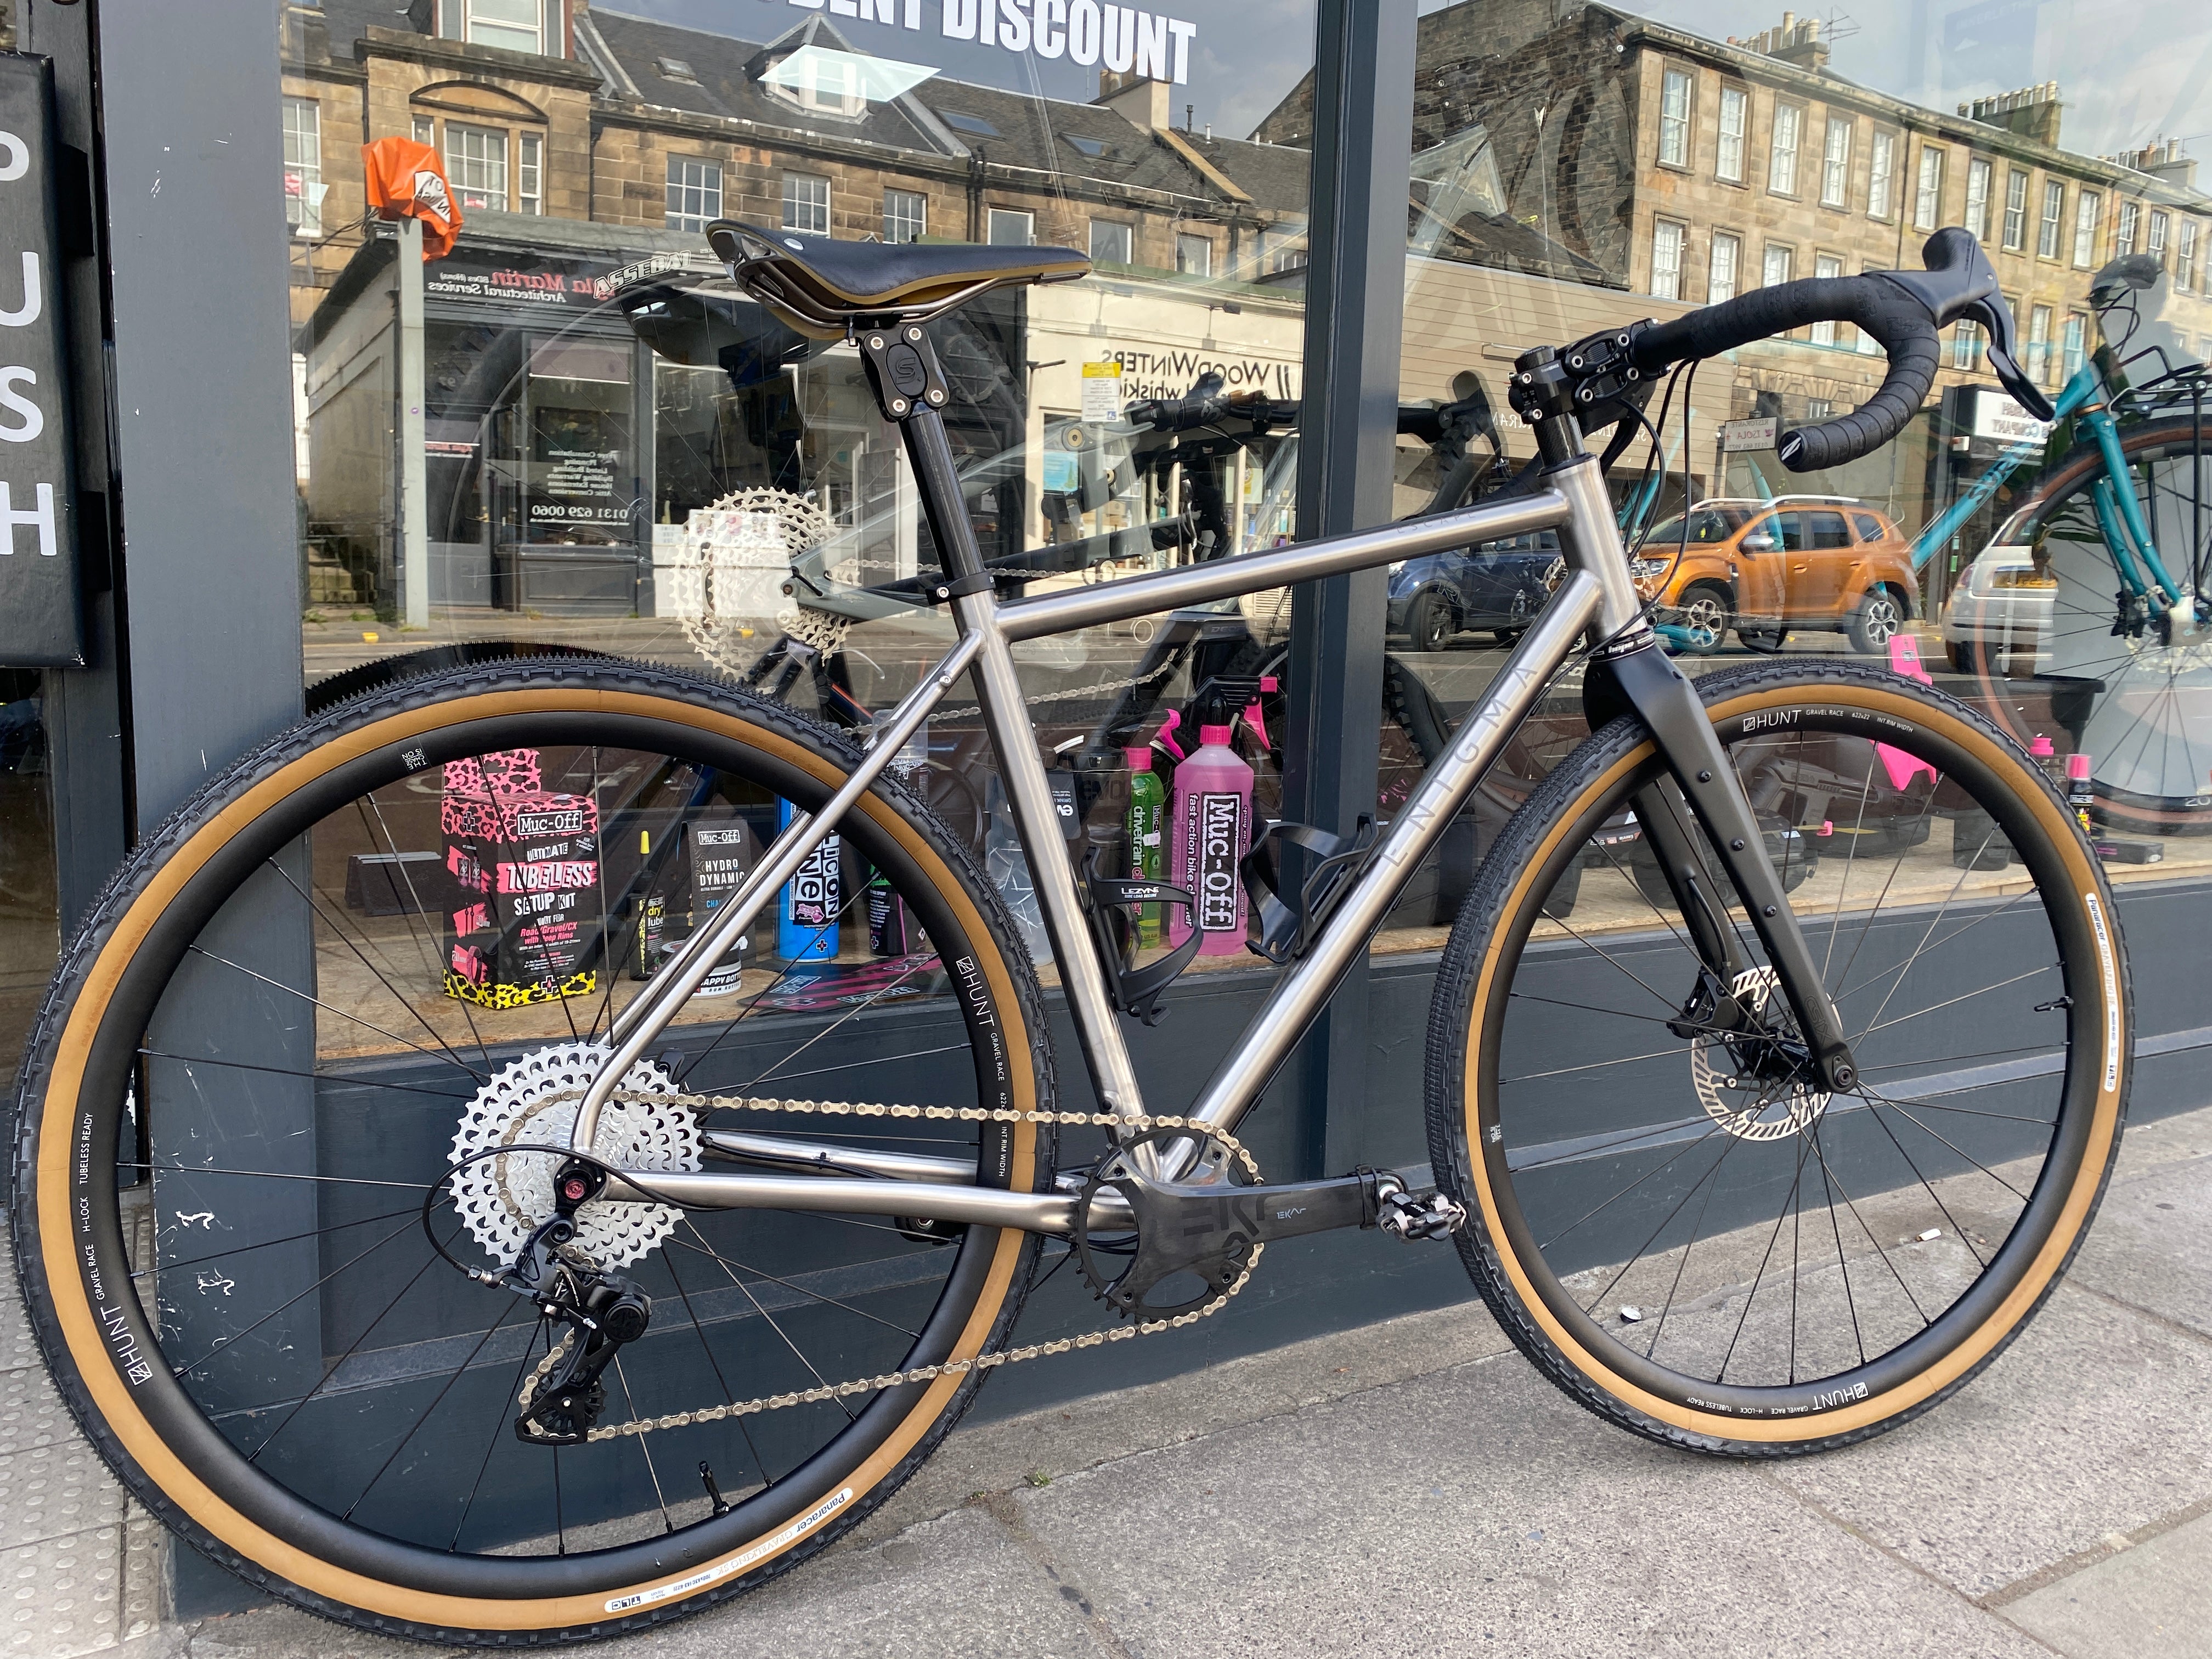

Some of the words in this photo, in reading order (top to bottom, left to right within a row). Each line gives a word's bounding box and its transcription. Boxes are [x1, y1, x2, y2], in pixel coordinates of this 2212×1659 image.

[943, 0, 1197, 85] DISCOUNT
[593, 250, 691, 300] ASSEGAI
[1609, 641, 1634, 653] hope
[1757, 709, 1802, 729] HUNT
[1380, 665, 1538, 867] ENIGMA
[1189, 793, 1198, 816] fast
[521, 813, 580, 832] Muc-Off
[700, 831, 738, 843] Muc-Off
[1132, 805, 1146, 866] drivetrain
[1188, 818, 1198, 856] action
[527, 842, 568, 862] ULTIMATE
[1205, 801, 1234, 924] Muc-Off
[506, 862, 592, 890] TUBELESS
[706, 859, 738, 872] HYDRO
[1187, 858, 1197, 882] bike
[699, 871, 745, 886] DYNAMIC
[514, 892, 555, 916] SETUP
[558, 893, 575, 910] KIT
[648, 906, 662, 916] dry
[534, 916, 551, 927] UILT
[553, 913, 565, 923] FOR
[648, 917, 664, 927] lube
[2089, 899, 2106, 941] Panaracer
[701, 977, 725, 986] APPY
[963, 972, 995, 1026] HUNT
[991, 1032, 1000, 1060] GRAVEL
[996, 1062, 1005, 1081] RACE
[82, 1113, 93, 1142] READY
[80, 1143, 90, 1185] TUBELESS
[998, 1154, 1007, 1177] WIDTH
[81, 1197, 91, 1232] H-LOCK
[85, 1243, 95, 1265] RACE
[91, 1265, 105, 1300] GRAVEL
[100, 1306, 144, 1368] HUNT
[1686, 1397, 1704, 1407] READY
[1706, 1401, 1732, 1412] TUBELESS
[1812, 1389, 1855, 1410] HUNT
[796, 1492, 845, 1533] Panaracer
[730, 1530, 793, 1569] GRAVELKING
